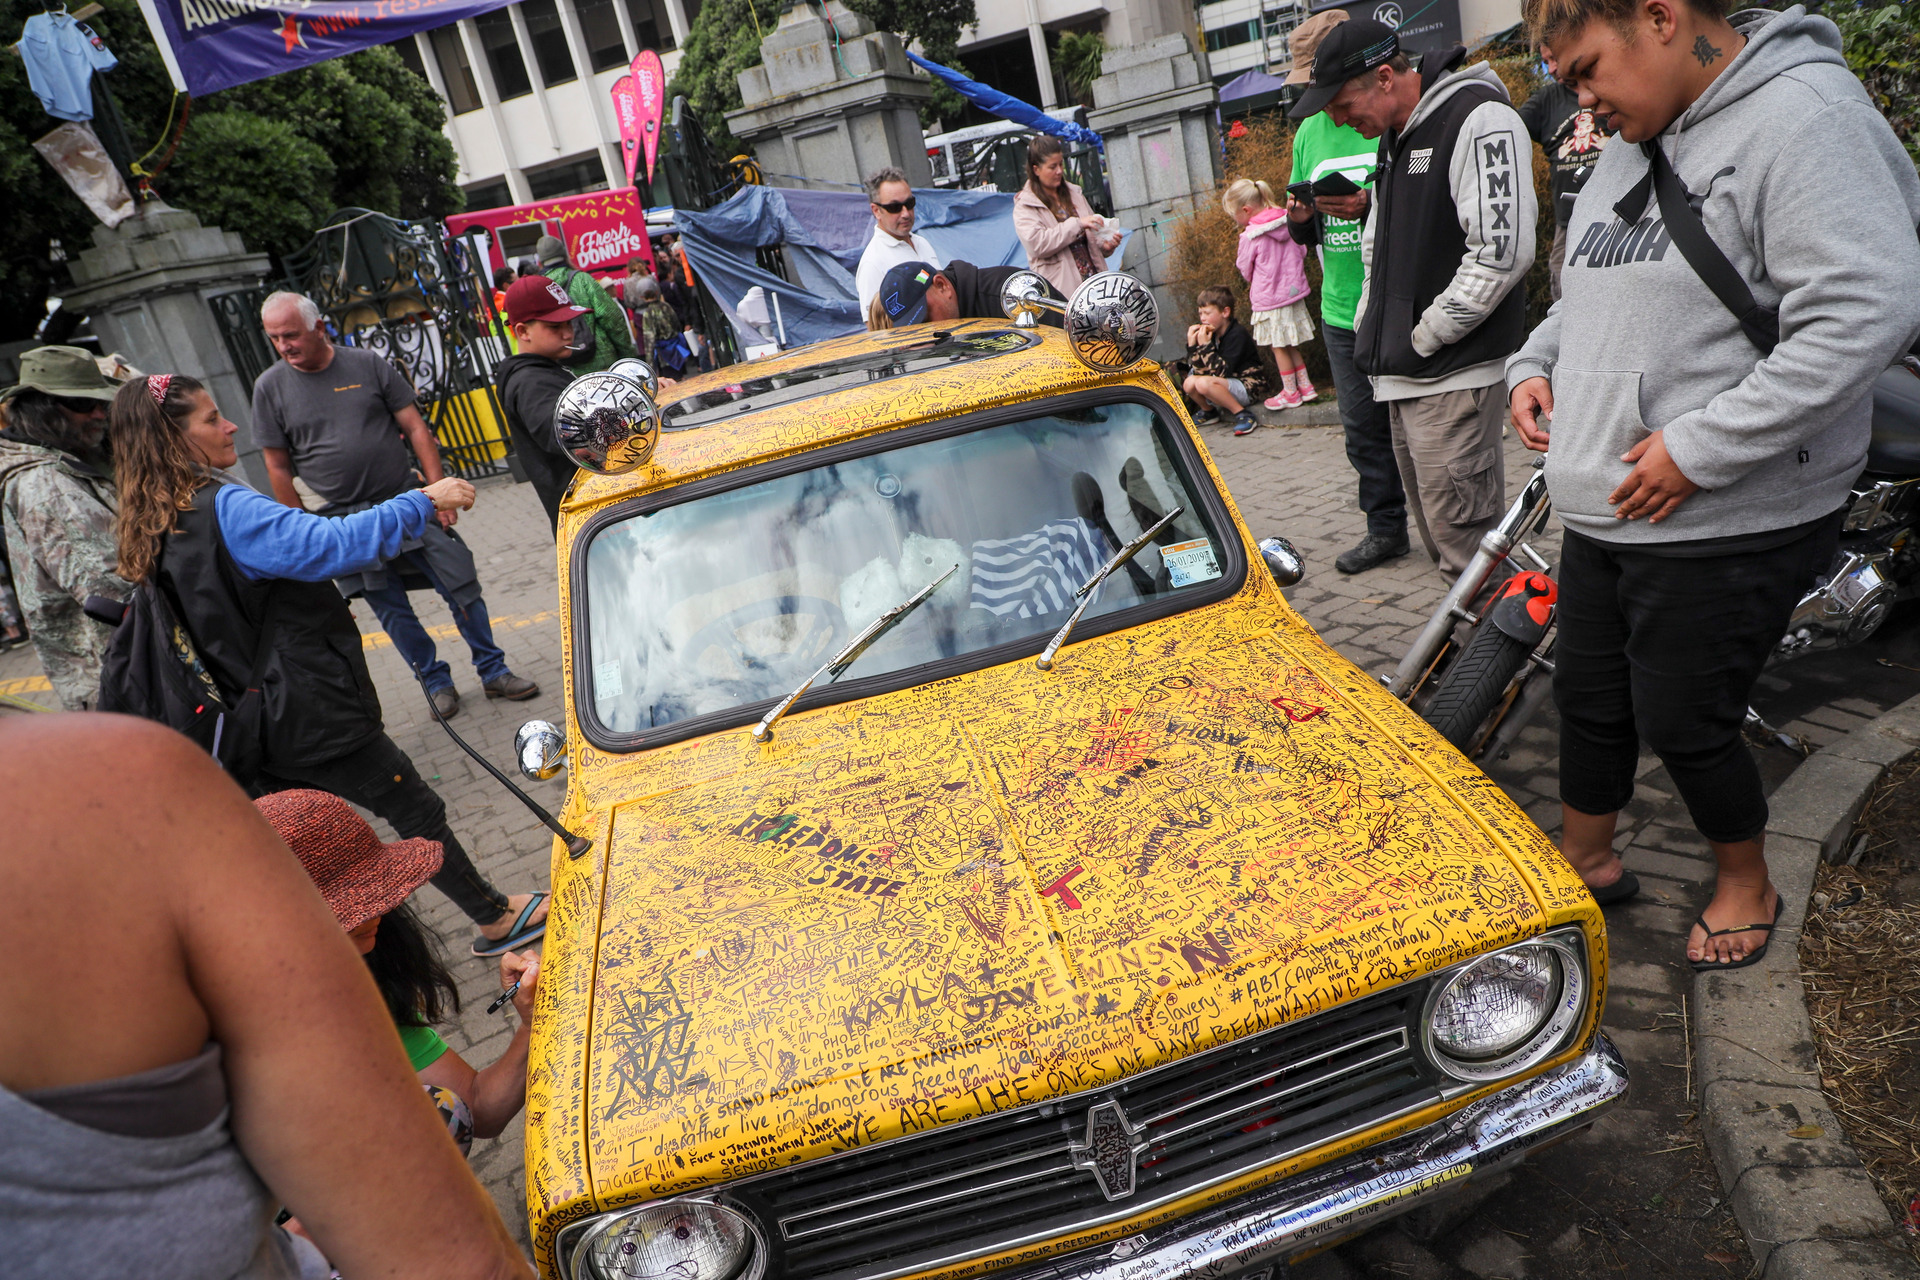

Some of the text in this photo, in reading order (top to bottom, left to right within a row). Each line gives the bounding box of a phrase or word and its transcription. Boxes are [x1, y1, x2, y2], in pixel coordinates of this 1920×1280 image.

[1484, 139, 1512, 262] MMXV
[577, 235, 641, 268] DONUTS
[580, 221, 631, 253] Fresh
[1569, 217, 1672, 268] PUMA
[1167, 552, 1204, 568] 26/01/2019
[807, 864, 907, 897] STATE
[1079, 941, 1165, 982] WINS
[1349, 946, 1383, 966] Brian
[841, 971, 976, 1033] KAYLA
[1026, 1008, 1088, 1035] CANADA
[899, 1094, 956, 1133] ARE
[1114, 1046, 1145, 1074] WE
[1209, 1010, 1270, 1041] BEEN
[1274, 976, 1359, 1022] WAITING
[718, 1093, 765, 1118] STAND
[807, 1084, 899, 1117] dangerous
[912, 1063, 980, 1094] freedom
[728, 1132, 776, 1155] JACINDA
[761, 1138, 805, 1157] RANKIN
[1316, 1146, 1347, 1161] Thanks
[1351, 1138, 1365, 1149] but
[721, 1156, 780, 1180] SENIOR
[1216, 1168, 1288, 1201] Wonderland Art
[1377, 1165, 1405, 1191] NEED
[1293, 1225, 1307, 1242] WE
[1310, 1221, 1333, 1234] WILL
[1335, 1210, 1353, 1225] NOT
[1358, 1202, 1380, 1217] GIVE
[984, 1254, 1014, 1270] FIND
[1017, 1246, 1052, 1262] YOUR
[1055, 1230, 1111, 1250] FREEDOM
